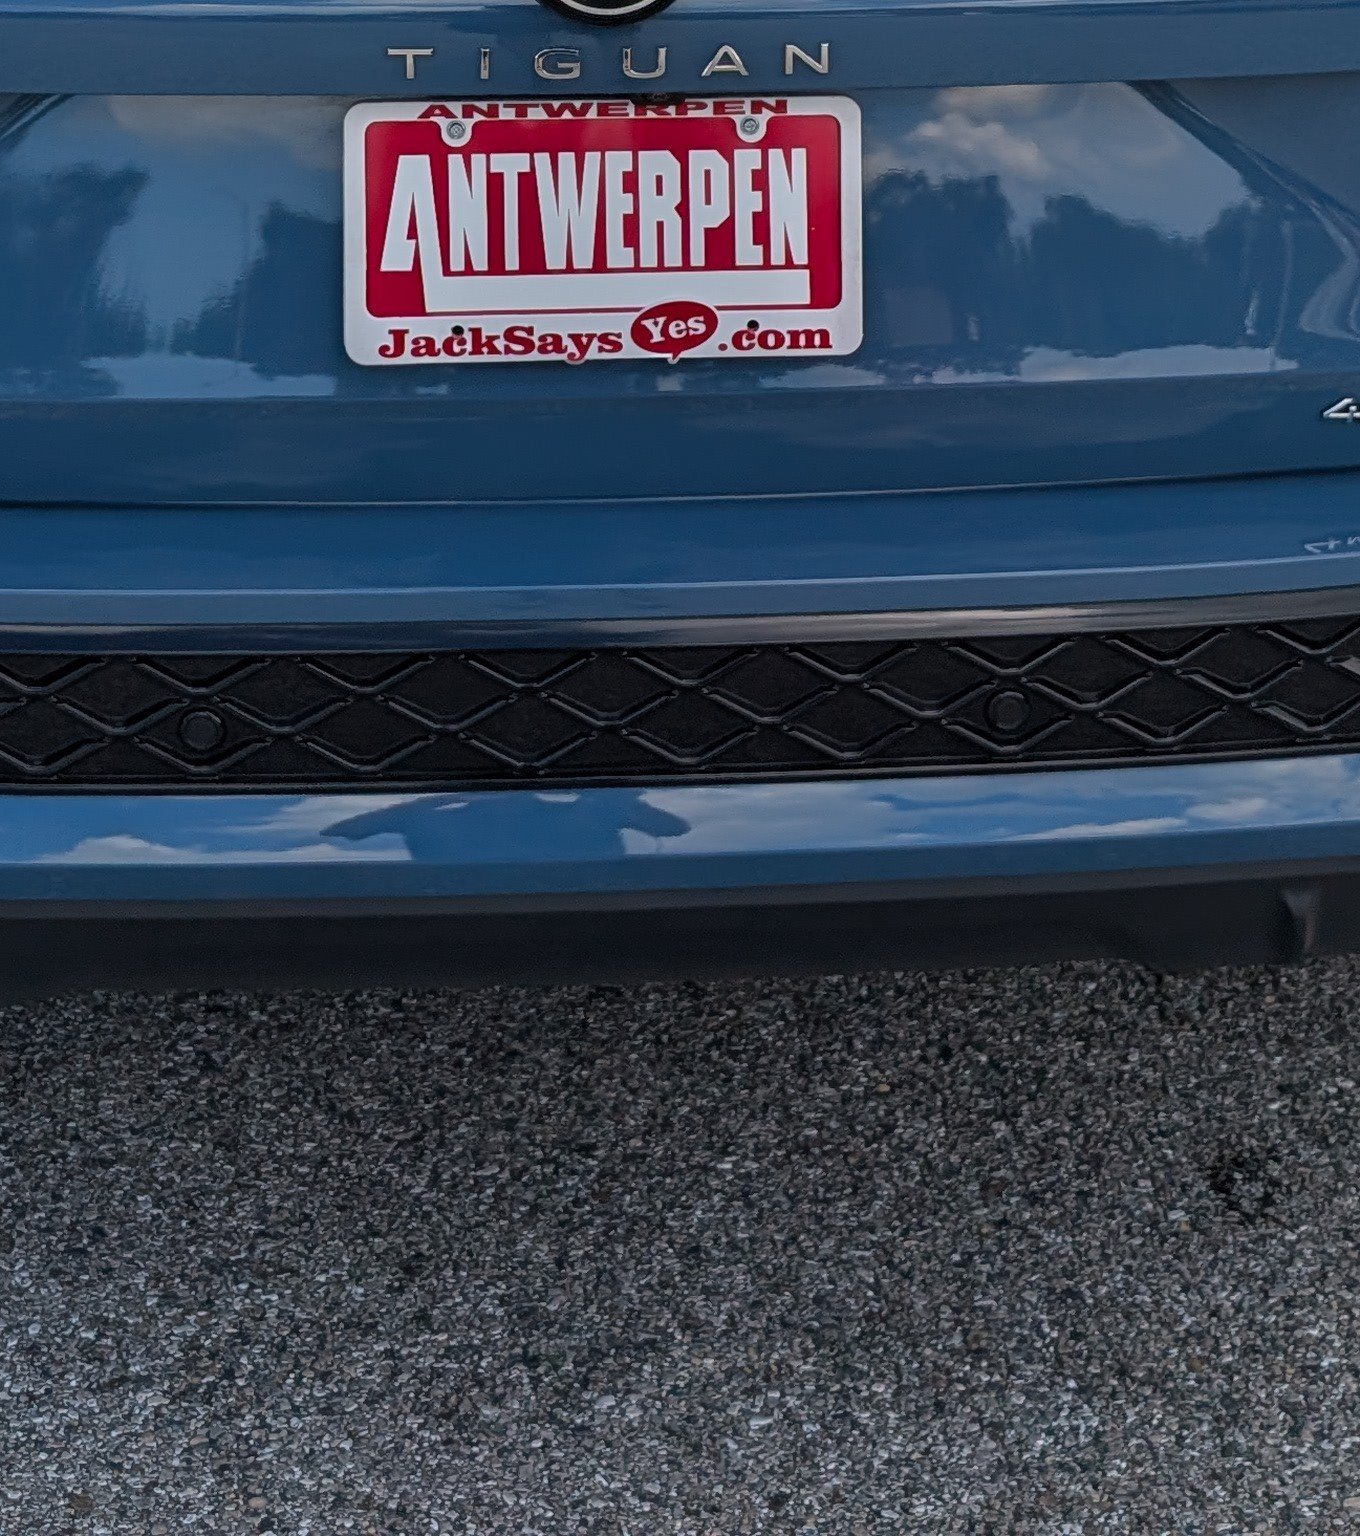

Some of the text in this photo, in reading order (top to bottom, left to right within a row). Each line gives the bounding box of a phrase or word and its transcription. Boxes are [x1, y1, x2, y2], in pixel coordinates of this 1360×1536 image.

[387, 42, 830, 80] TIGUAN
[417, 99, 788, 120] ANTWERPEN
[379, 147, 810, 312] ANTWERPEN
[641, 312, 707, 344] Yes
[718, 325, 833, 352] .com
